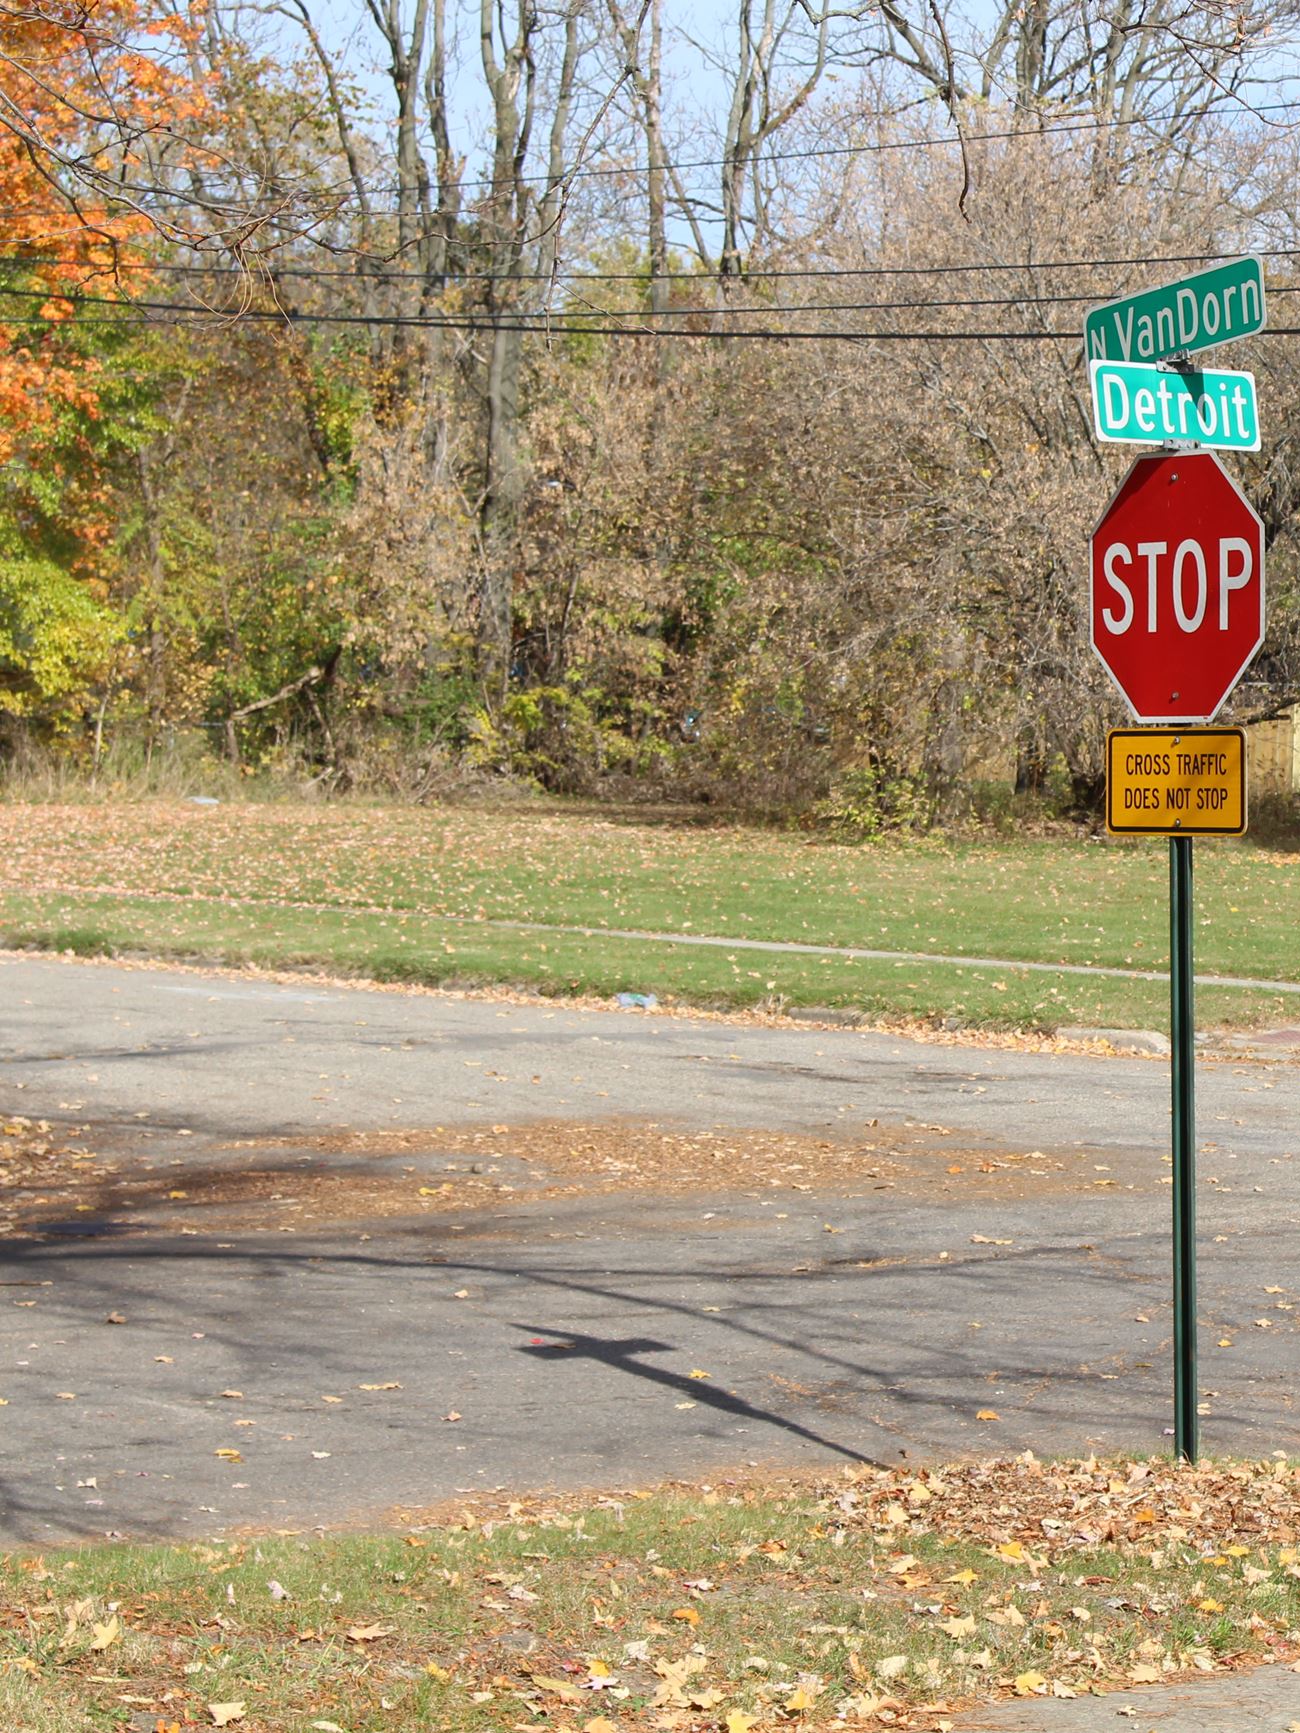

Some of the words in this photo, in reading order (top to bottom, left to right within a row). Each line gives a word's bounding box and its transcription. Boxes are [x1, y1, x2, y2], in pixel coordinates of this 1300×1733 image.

[1091, 326, 1106, 360] N
[1113, 279, 1260, 362] VanDorn
[1102, 373, 1250, 439] Detroit
[1102, 537, 1253, 635] STOP
[1126, 754, 1170, 775] CROSS
[1176, 754, 1227, 775] TRAFFIC
[1124, 788, 1160, 809] DOES
[1166, 788, 1191, 809] NOT
[1196, 788, 1228, 809] STOP
